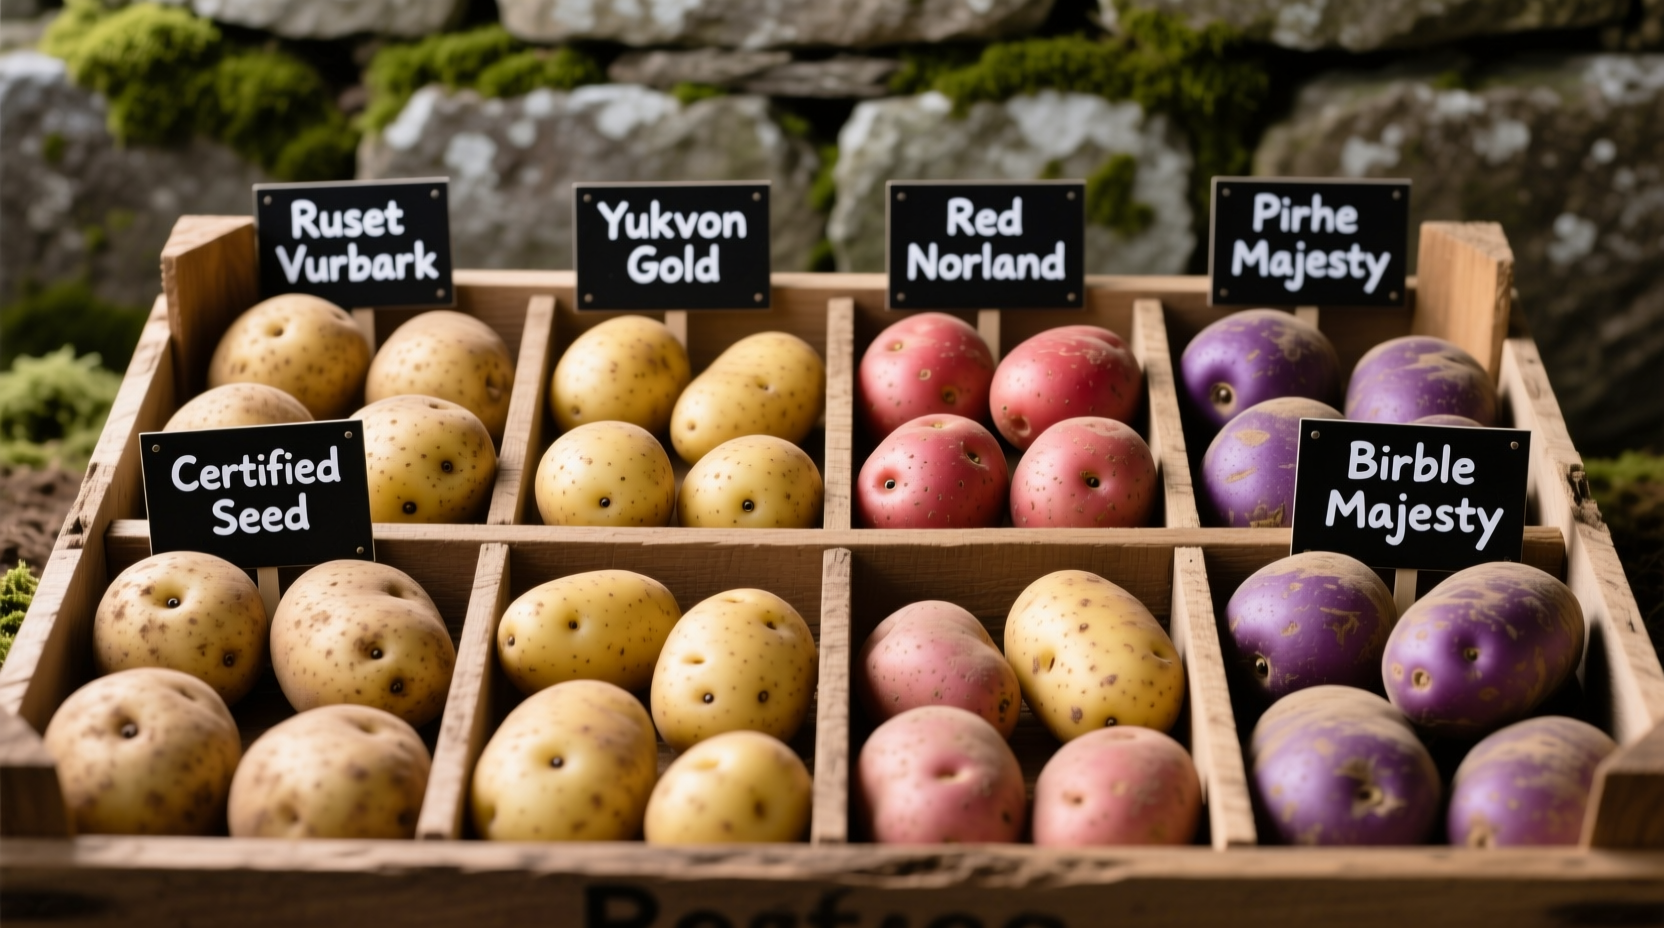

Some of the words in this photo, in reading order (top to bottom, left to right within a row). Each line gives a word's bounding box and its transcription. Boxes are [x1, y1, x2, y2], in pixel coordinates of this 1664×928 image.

[290, 199, 405, 239] Ruset
[597, 199, 748, 241] Yukvon
[946, 196, 1023, 237] Red
[1253, 193, 1358, 234] Pirhe
[275, 240, 439, 284] Vurbark
[627, 243, 720, 284] Gold
[907, 241, 1066, 282] Norland
[1231, 239, 1391, 293] Majesty
[171, 445, 341, 492] Certified
[1347, 440, 1475, 486] Birble
[212, 492, 311, 536] Seed
[1325, 489, 1504, 551] Majesty
